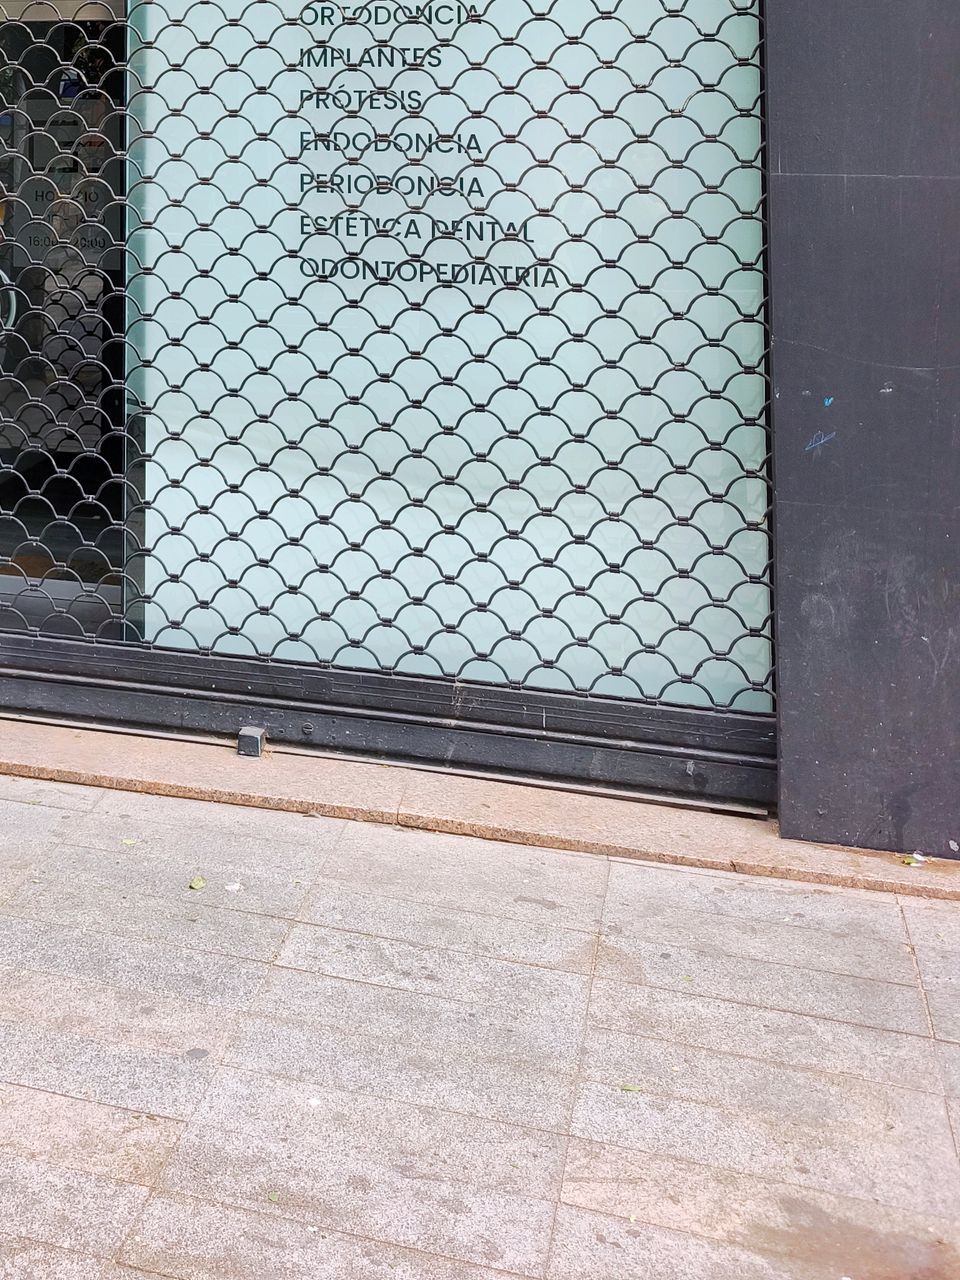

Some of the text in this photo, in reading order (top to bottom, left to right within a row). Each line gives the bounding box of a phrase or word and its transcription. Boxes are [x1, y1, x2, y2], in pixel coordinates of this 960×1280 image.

[300, 5, 482, 26] ORTODONCIA
[300, 48, 442, 68] IMPLANTES
[300, 84, 422, 110] PRÓTESIS
[300, 131, 482, 154] ENDODONCIA
[300, 173, 484, 197] PERIODONCIA
[300, 211, 534, 243] ESTÉTICA DENTAL
